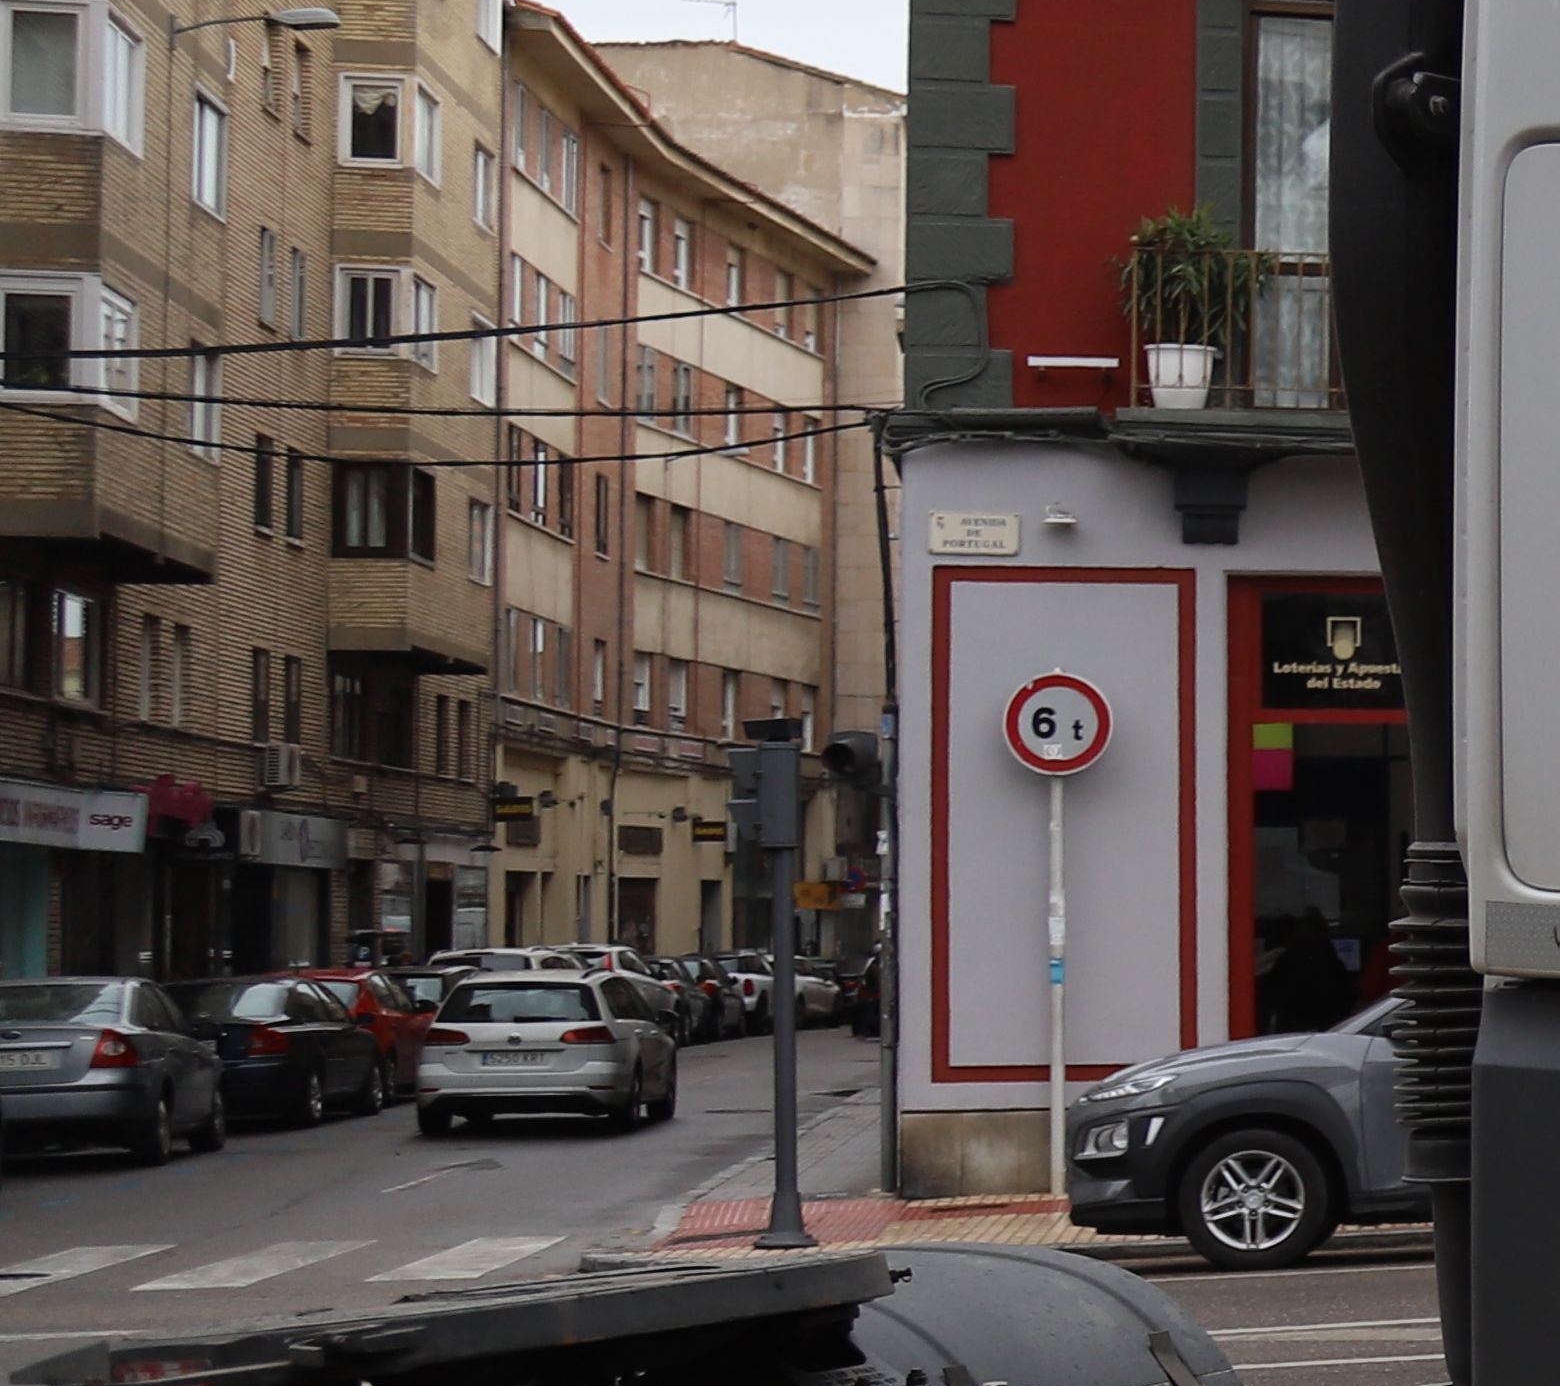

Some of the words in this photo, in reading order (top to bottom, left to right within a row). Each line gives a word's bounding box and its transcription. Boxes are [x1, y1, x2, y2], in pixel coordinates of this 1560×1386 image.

[961, 517, 1007, 527] AVENIDA
[966, 529, 981, 538] DE
[943, 539, 1007, 549] PORTUGAL
[1273, 661, 1332, 675] Loterías
[1336, 664, 1345, 677] y
[1306, 678, 1329, 690] del
[1332, 678, 1382, 690] Estado
[1032, 706, 1057, 740] 6
[1072, 719, 1084, 741] t
[90, 813, 133, 831] sage
